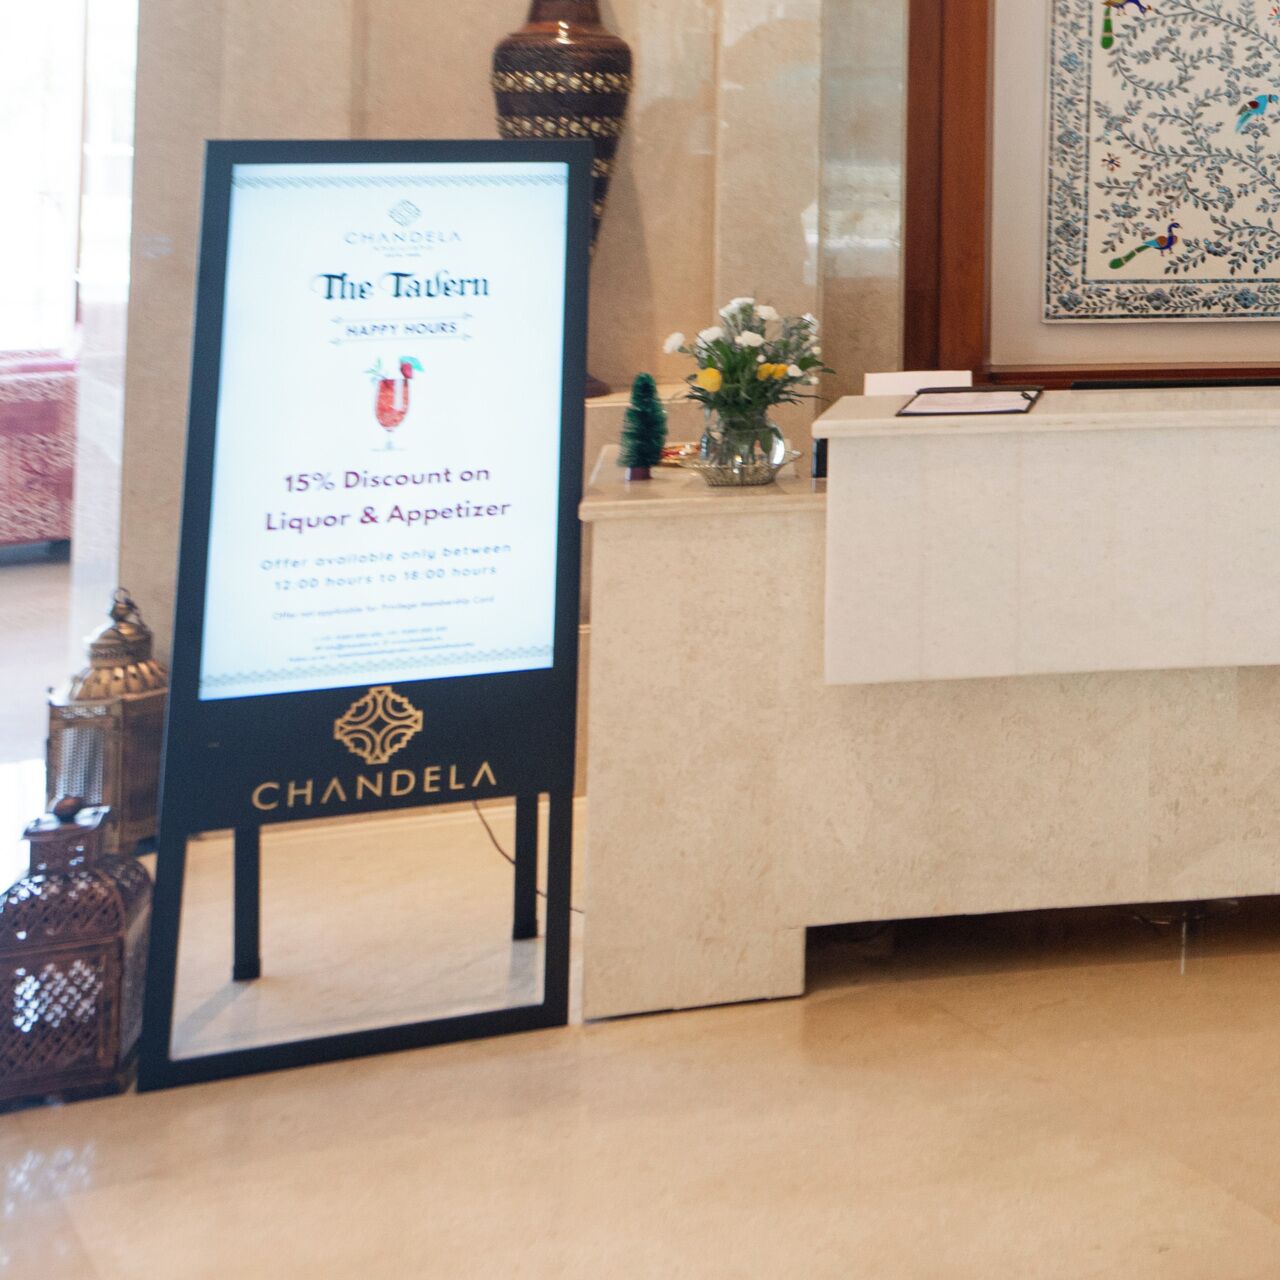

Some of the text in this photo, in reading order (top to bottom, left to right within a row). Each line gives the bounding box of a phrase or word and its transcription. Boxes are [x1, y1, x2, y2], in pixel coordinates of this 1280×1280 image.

[344, 231, 463, 245] CHANDELA
[311, 269, 490, 301] The Tavern
[346, 322, 457, 336] HAPPY HOURS
[285, 468, 490, 493] 15% Discount on
[265, 500, 512, 535] Liquor & Appetizer
[260, 544, 512, 571] Offer available only between
[325, 575, 374, 588] hours
[380, 572, 397, 583] to
[451, 565, 498, 578] hours
[251, 761, 498, 811] CHANDELA
